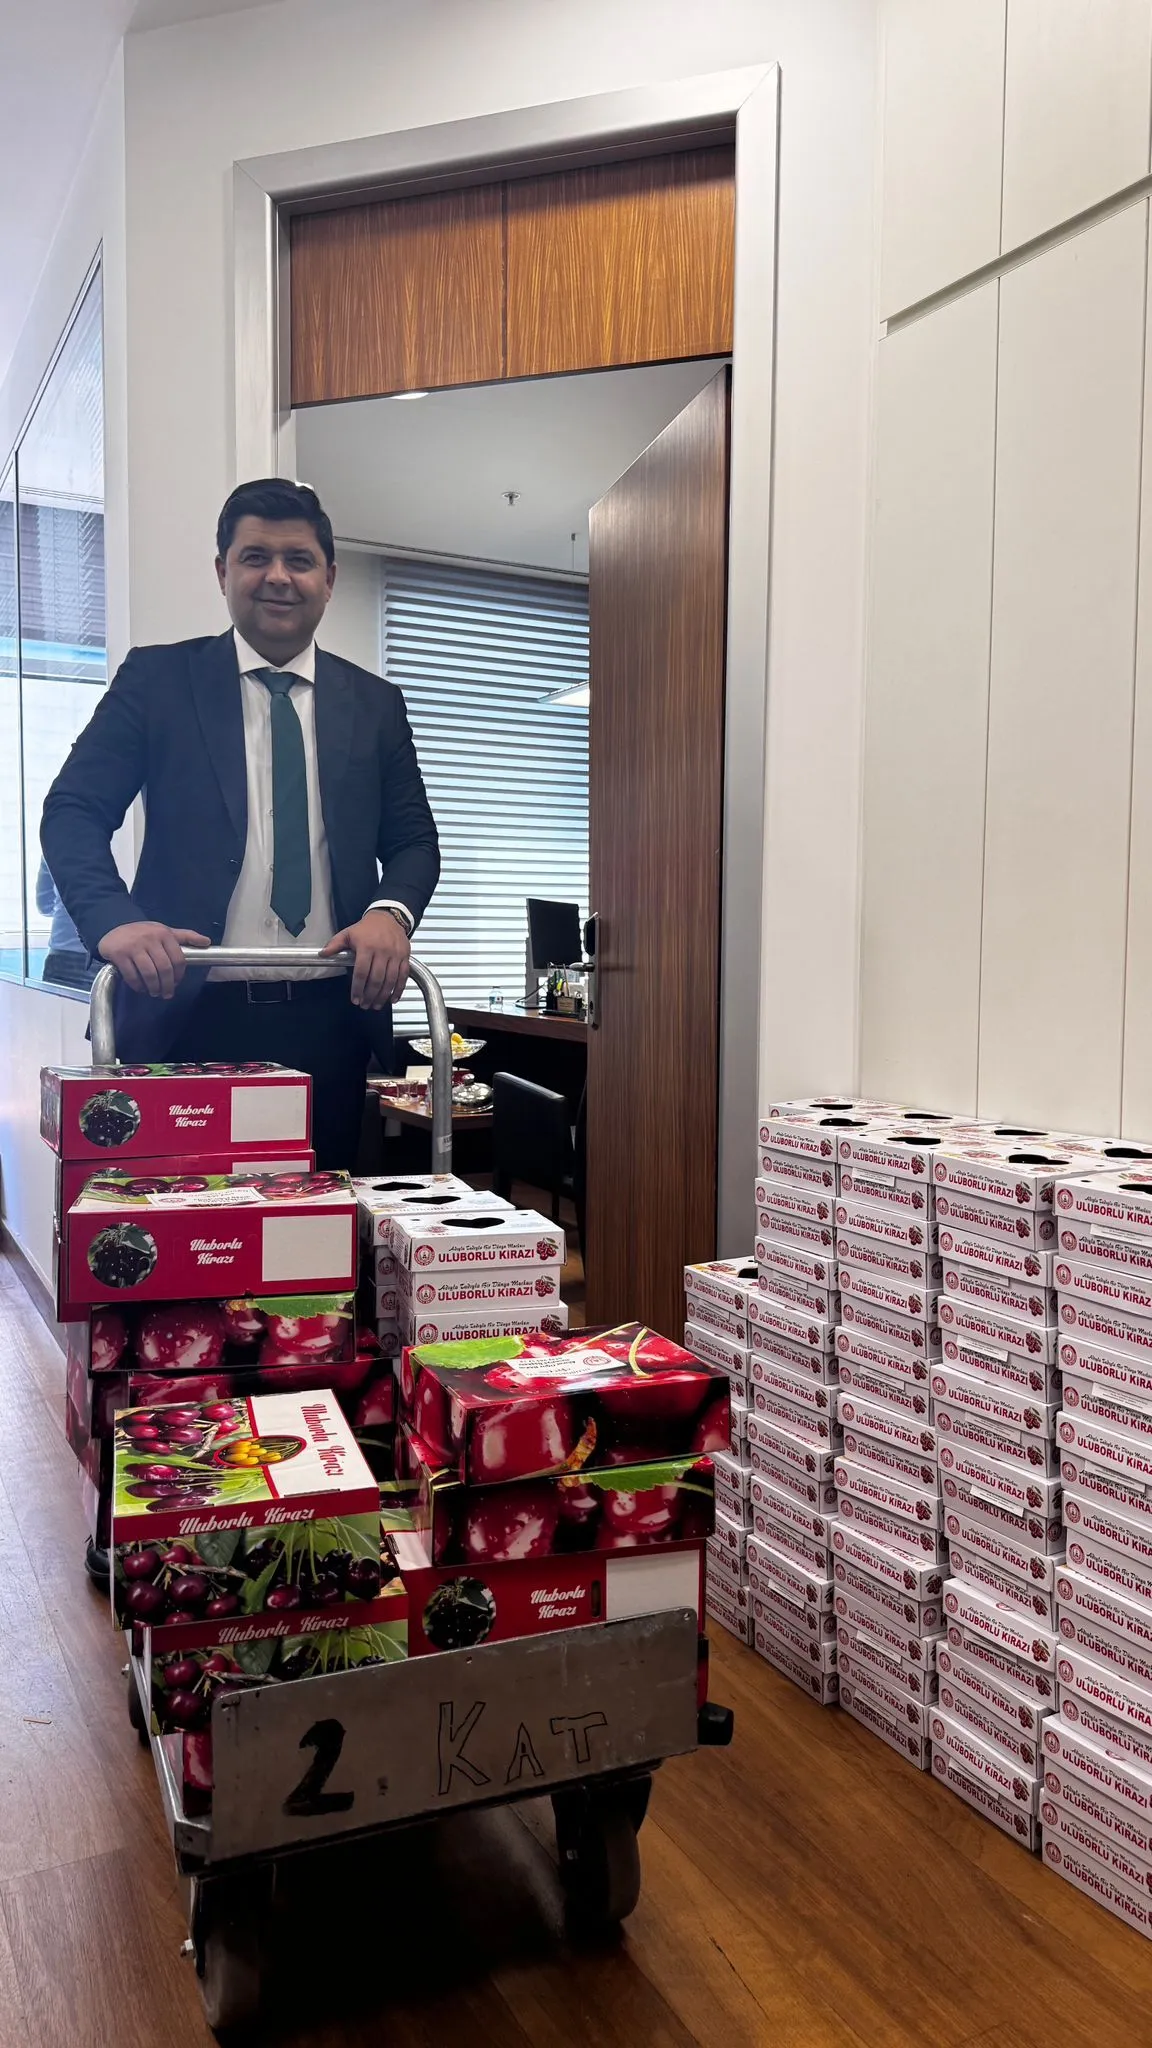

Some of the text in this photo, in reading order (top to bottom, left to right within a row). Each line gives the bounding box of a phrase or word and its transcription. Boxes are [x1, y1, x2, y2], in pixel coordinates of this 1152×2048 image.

[168, 1104, 215, 1115] Uluborlu
[853, 1151, 885, 1165] ULUBORLU
[854, 1184, 887, 1199] ULUBORLU
[949, 1173, 986, 1191] ULUBORLU
[950, 1207, 988, 1225] ULUBORLU
[1076, 1200, 1123, 1219] ULUBORLU
[849, 1217, 883, 1233] ULUBORLU
[190, 1237, 243, 1251] Uluborlu
[954, 1243, 993, 1262] ULUBORLU
[1078, 1242, 1126, 1262] ULUBORLU
[438, 1251, 496, 1263] ULUBORLU
[850, 1249, 887, 1267] ULUBORLU
[437, 1288, 495, 1302] ULUBORLU
[852, 1282, 883, 1300] ULUBORLU
[960, 1282, 998, 1301] ULUBORLU
[1074, 1277, 1119, 1298] ULUBORLU
[442, 1328, 499, 1341] ULUBORLU
[855, 1315, 887, 1333] ULUBORLU
[956, 1316, 995, 1337] ULUBORLU
[1078, 1316, 1124, 1339] ULUBORLU
[851, 1345, 886, 1365] ULUBORLU
[960, 1353, 999, 1375] ULUBORLU
[1080, 1357, 1126, 1381] ULUBORLU
[853, 1378, 887, 1398] ULUBORLU
[949, 1389, 990, 1411] ULUBORLU
[300, 1404, 338, 1442] Uluborlu
[1081, 1399, 1128, 1425] ULUBORLU
[856, 1414, 892, 1435] ULUBORLU
[953, 1425, 996, 1448] ULUBORLU
[859, 1446, 895, 1468] ULUBORLU
[1077, 1436, 1123, 1463] ULUBORLU
[956, 1461, 995, 1487] ULUBORLU
[849, 1479, 886, 1502] ULUBORLU
[1079, 1475, 1126, 1503] ULUBORLU
[958, 1493, 996, 1516] ULUBORLU
[178, 1511, 253, 1534] Uluborlu
[855, 1511, 892, 1533] ULUBORLU
[1083, 1516, 1130, 1547] ULUBORLU
[962, 1529, 1000, 1557] ULUBORLU
[845, 1544, 878, 1569] ULUBORLU
[965, 1564, 1004, 1593] ULUBORLU
[1086, 1558, 1132, 1589] ULUBORLU
[530, 1585, 586, 1604] Uluborlu
[960, 1607, 999, 1637] ULUBORLU
[1076, 1594, 1123, 1627] ULUBORLU
[218, 1622, 290, 1644] Uluborlu
[849, 1610, 883, 1638] ULUBORLU
[964, 1641, 1004, 1671] ULUBORLU
[1077, 1633, 1125, 1666] ULUBORLU
[953, 1667, 990, 1700] ULUBORLU
[1076, 1677, 1124, 1712] ULUBORLU
[954, 1702, 992, 1736] ULUBORLU
[1081, 1715, 1132, 1752] ULUBORLU
[438, 1700, 608, 1796] KAT
[946, 1735, 982, 1769] ULUBORLU
[1063, 1749, 1110, 1786] ULUBORLU
[1063, 1789, 1111, 1828] ULUBORLU
[1061, 1820, 1108, 1861] ULUBORLU
[1063, 1858, 1112, 1900] ULUBORLU
